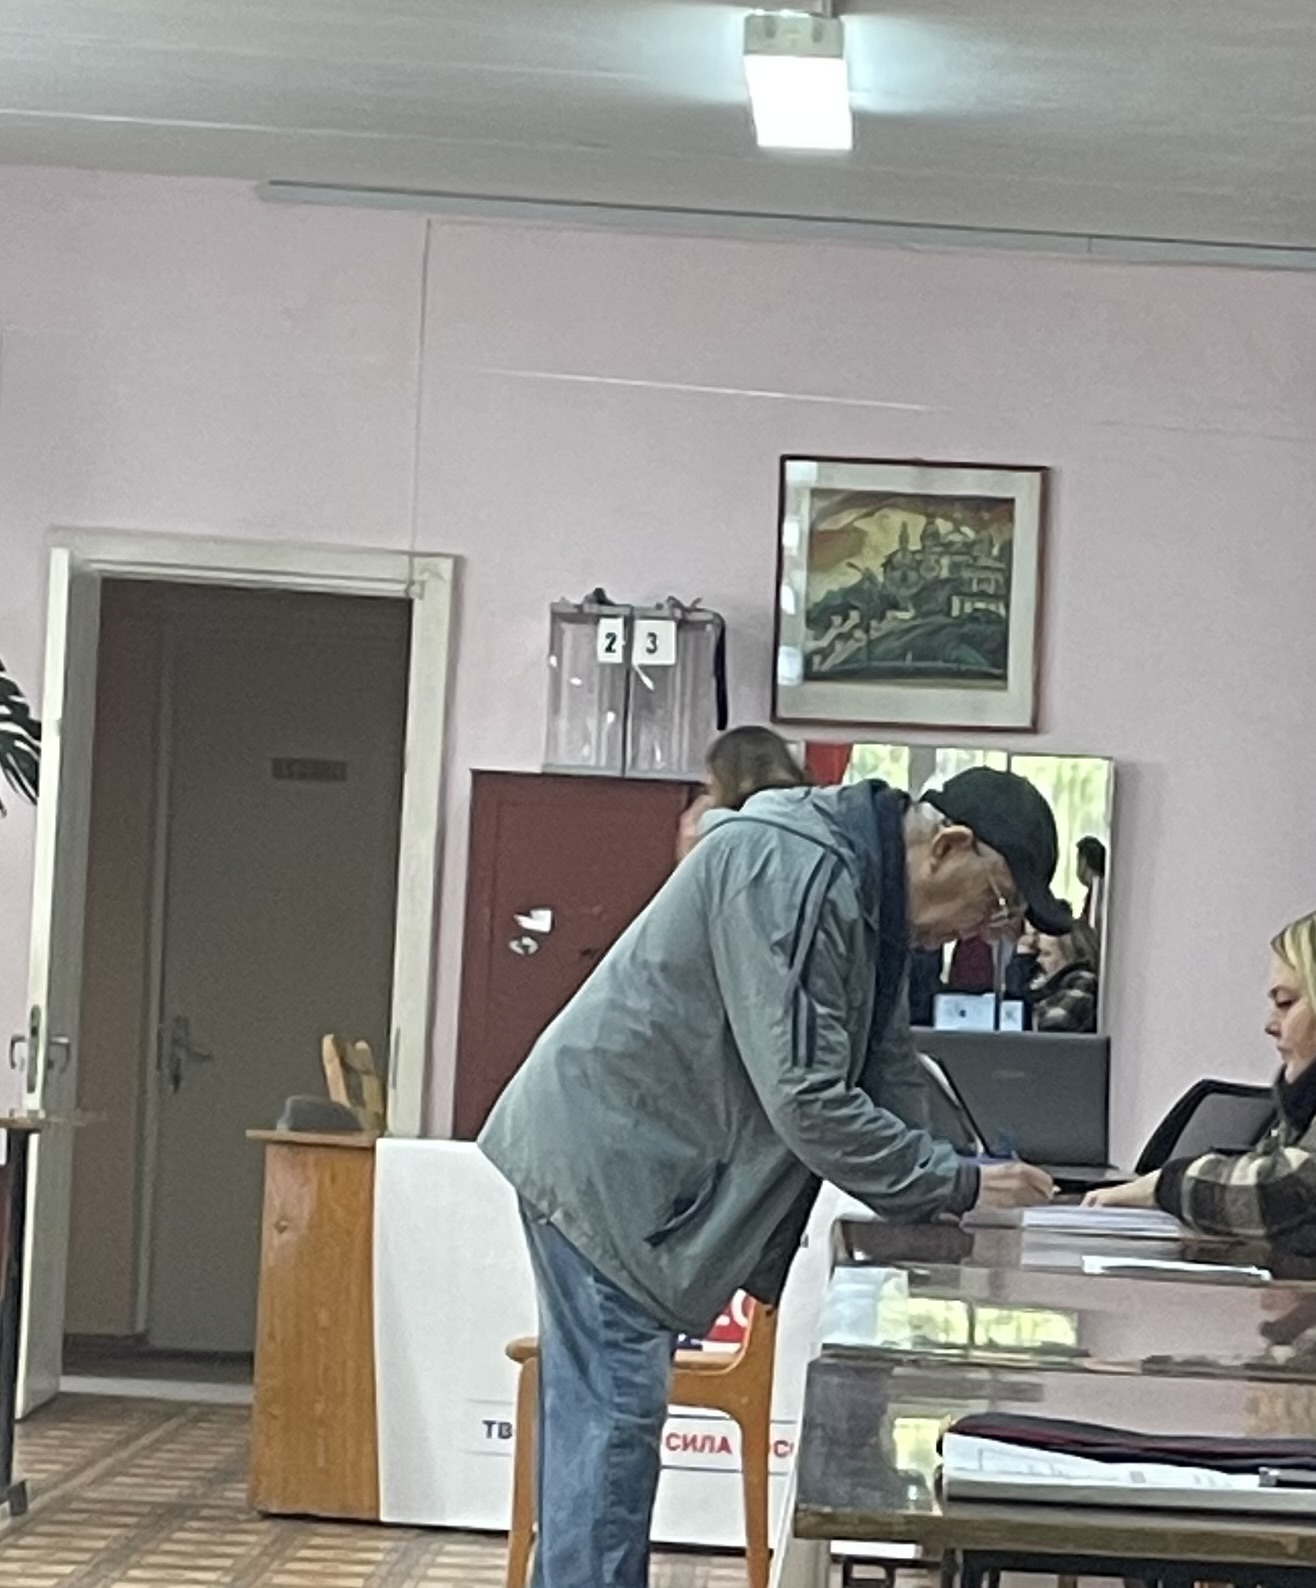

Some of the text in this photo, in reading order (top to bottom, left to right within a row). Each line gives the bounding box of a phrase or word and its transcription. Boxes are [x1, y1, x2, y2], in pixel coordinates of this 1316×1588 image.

[605, 632, 617, 653] 2
[646, 632, 658, 654] 3
[482, 1420, 732, 1455] ТВ СИЛА
